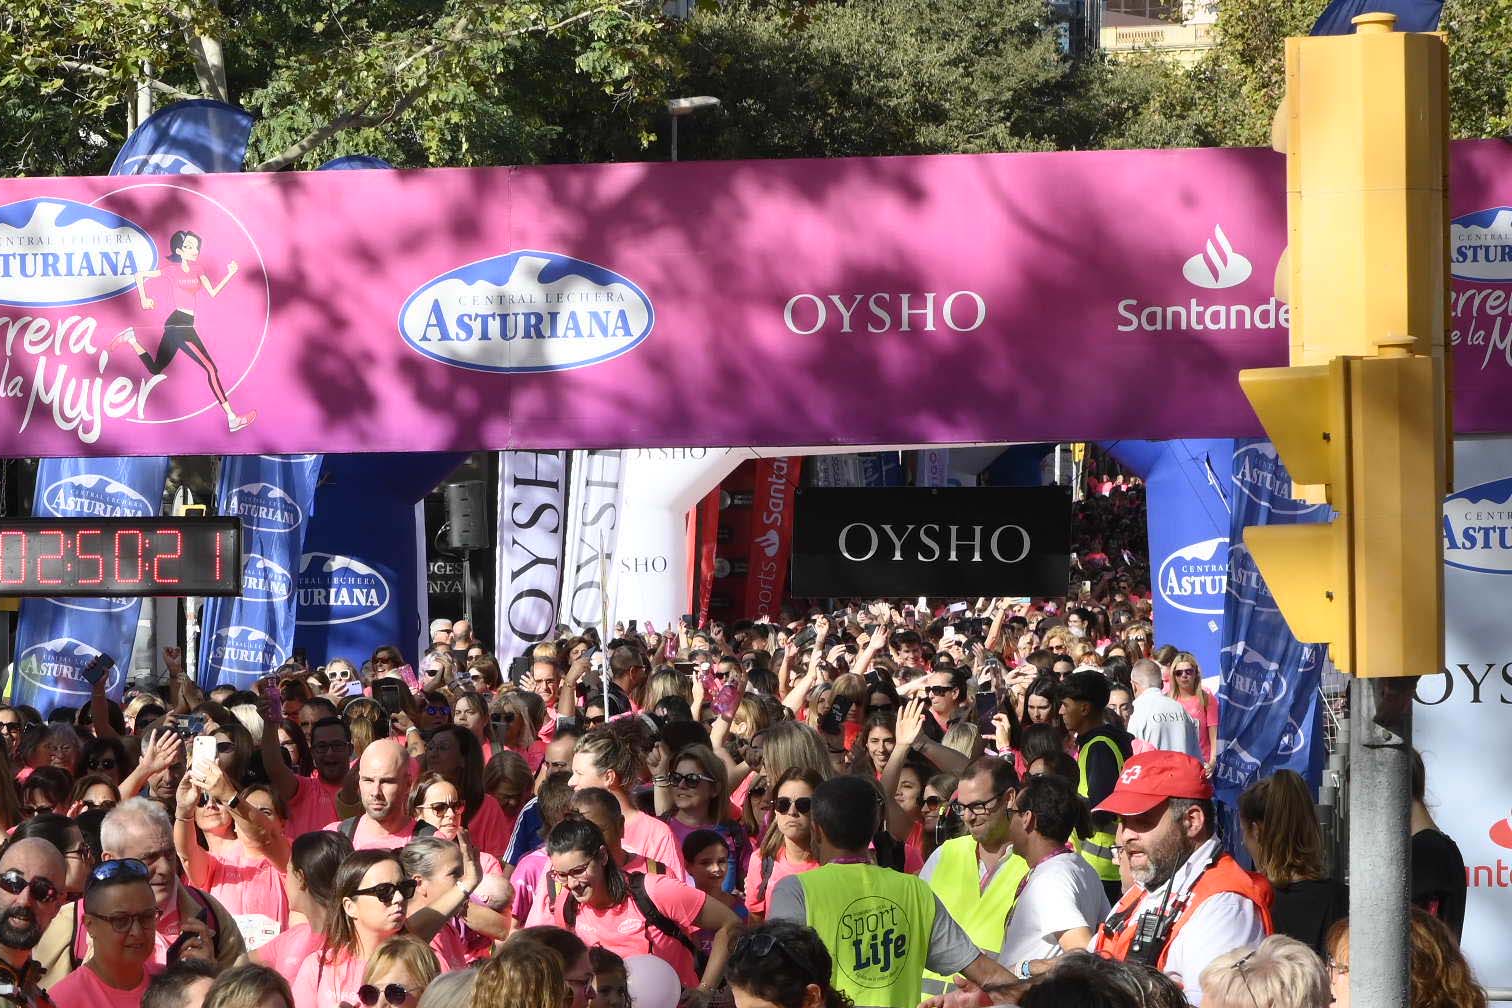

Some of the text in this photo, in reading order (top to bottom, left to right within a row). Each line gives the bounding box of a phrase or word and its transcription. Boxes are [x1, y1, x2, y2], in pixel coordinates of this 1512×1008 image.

[1458, 232, 1510, 241] CENTRAL
[1451, 244, 1512, 264] STUR
[458, 291, 625, 306] CENTRAL LECHERA
[783, 290, 987, 335] OYSHO
[1451, 288, 1512, 318] rre
[419, 298, 633, 342] ASTURIANA
[1116, 298, 1290, 331] Santande
[1468, 317, 1485, 346] la
[0, 358, 23, 398] la
[18, 350, 168, 444] Mujer
[838, 522, 1031, 564] OYSHO
[327, 576, 375, 585] LECHERA
[25, 654, 87, 681] ASTURI
[841, 904, 898, 940] Sport
[852, 928, 906, 973] Life
